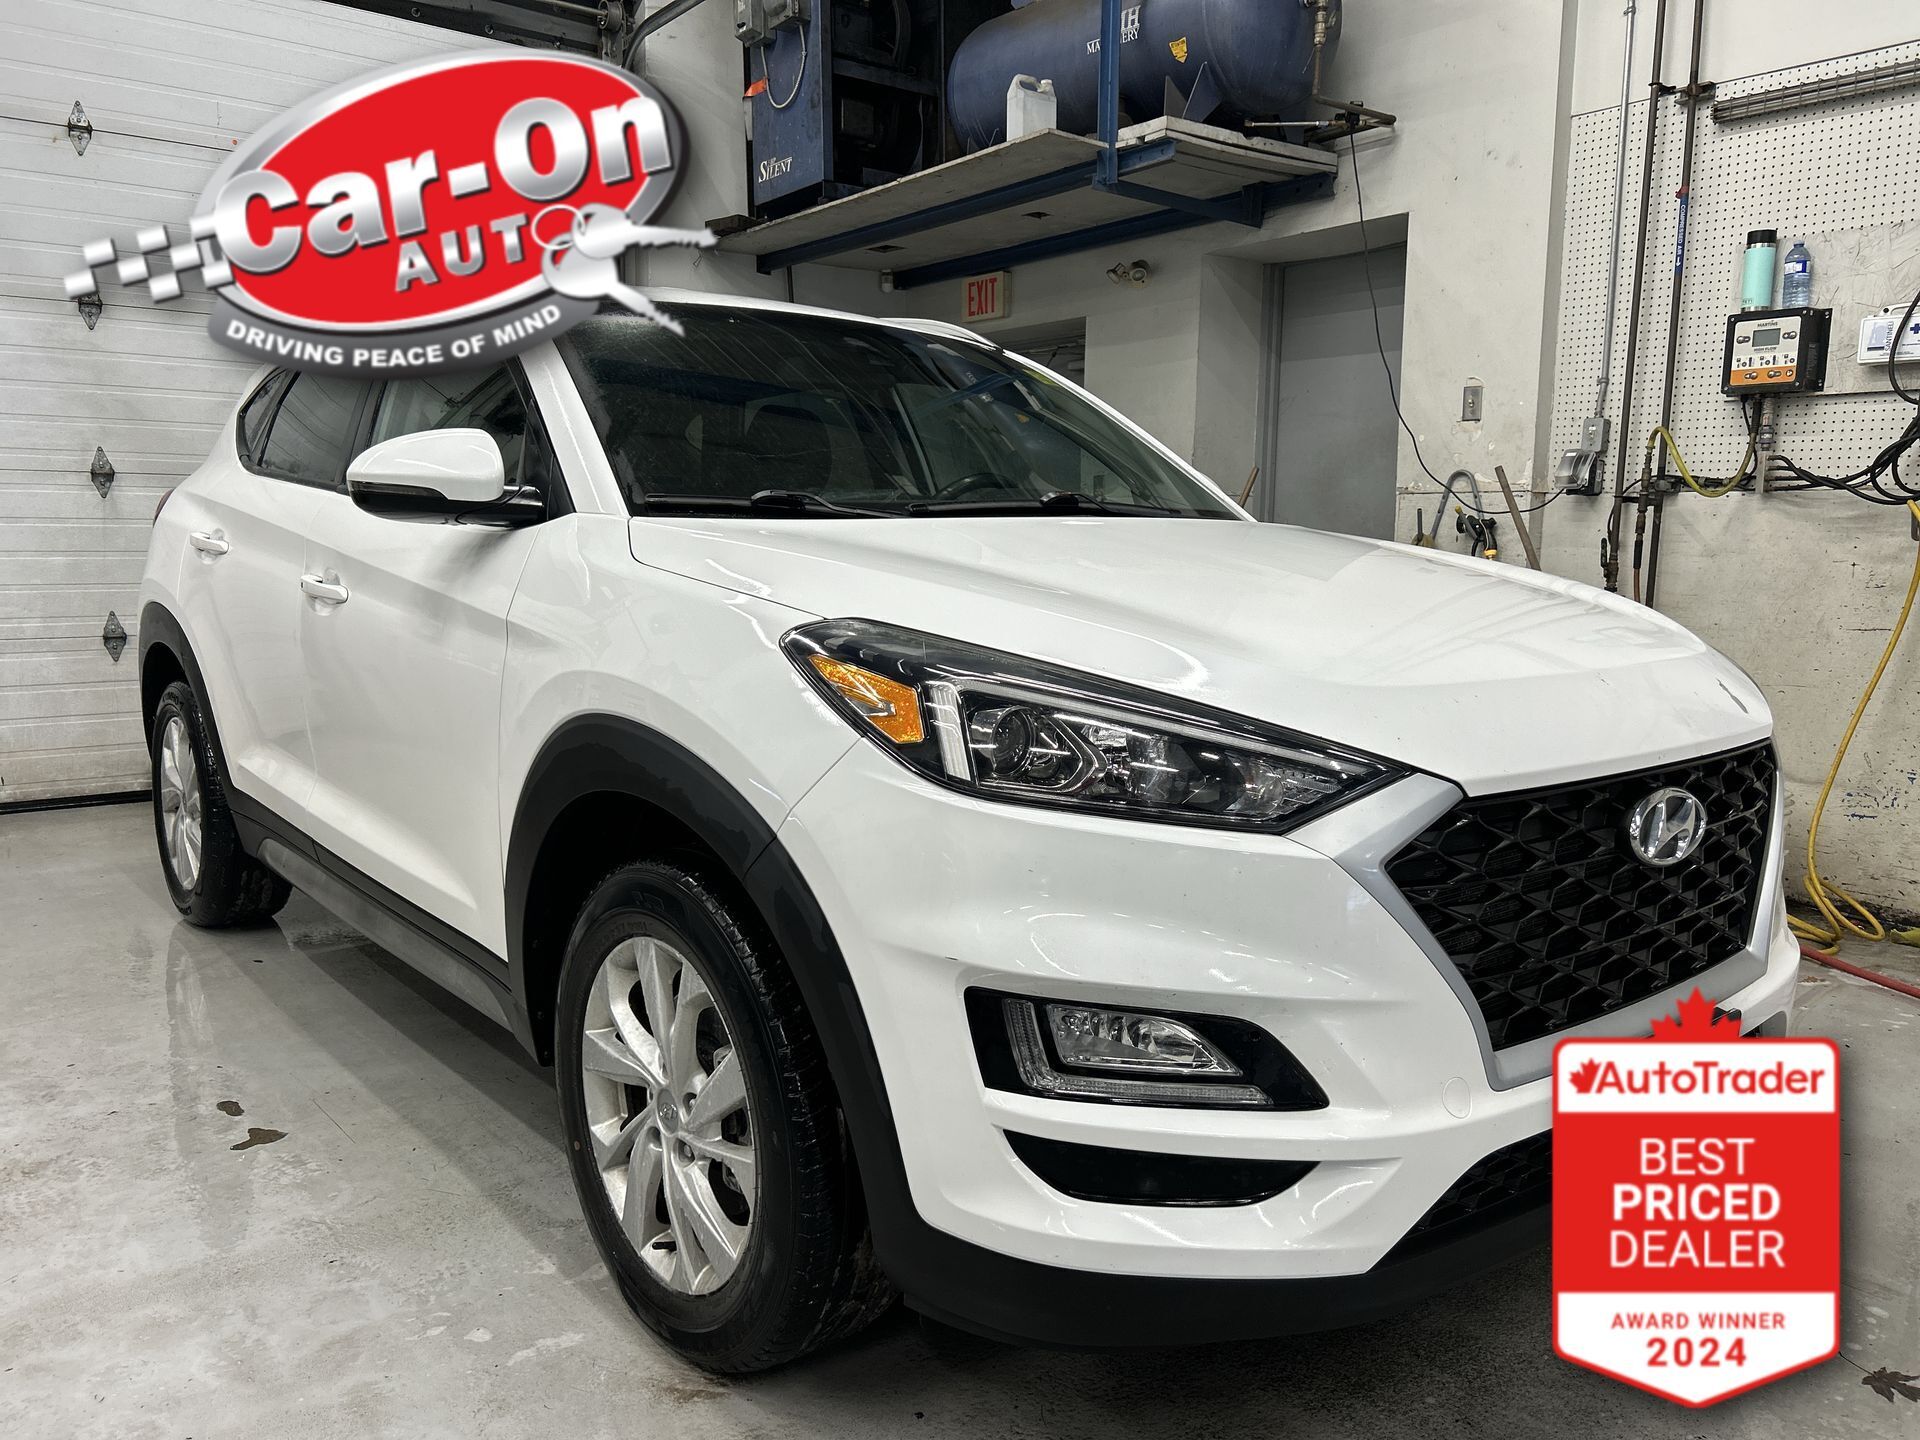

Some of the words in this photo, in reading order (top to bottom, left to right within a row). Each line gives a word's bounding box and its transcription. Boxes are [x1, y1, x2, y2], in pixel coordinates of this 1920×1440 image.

[758, 157, 792, 183] SILENT
[1677, 204, 1686, 244] COMPRESSED
[968, 277, 997, 316] EXIT
